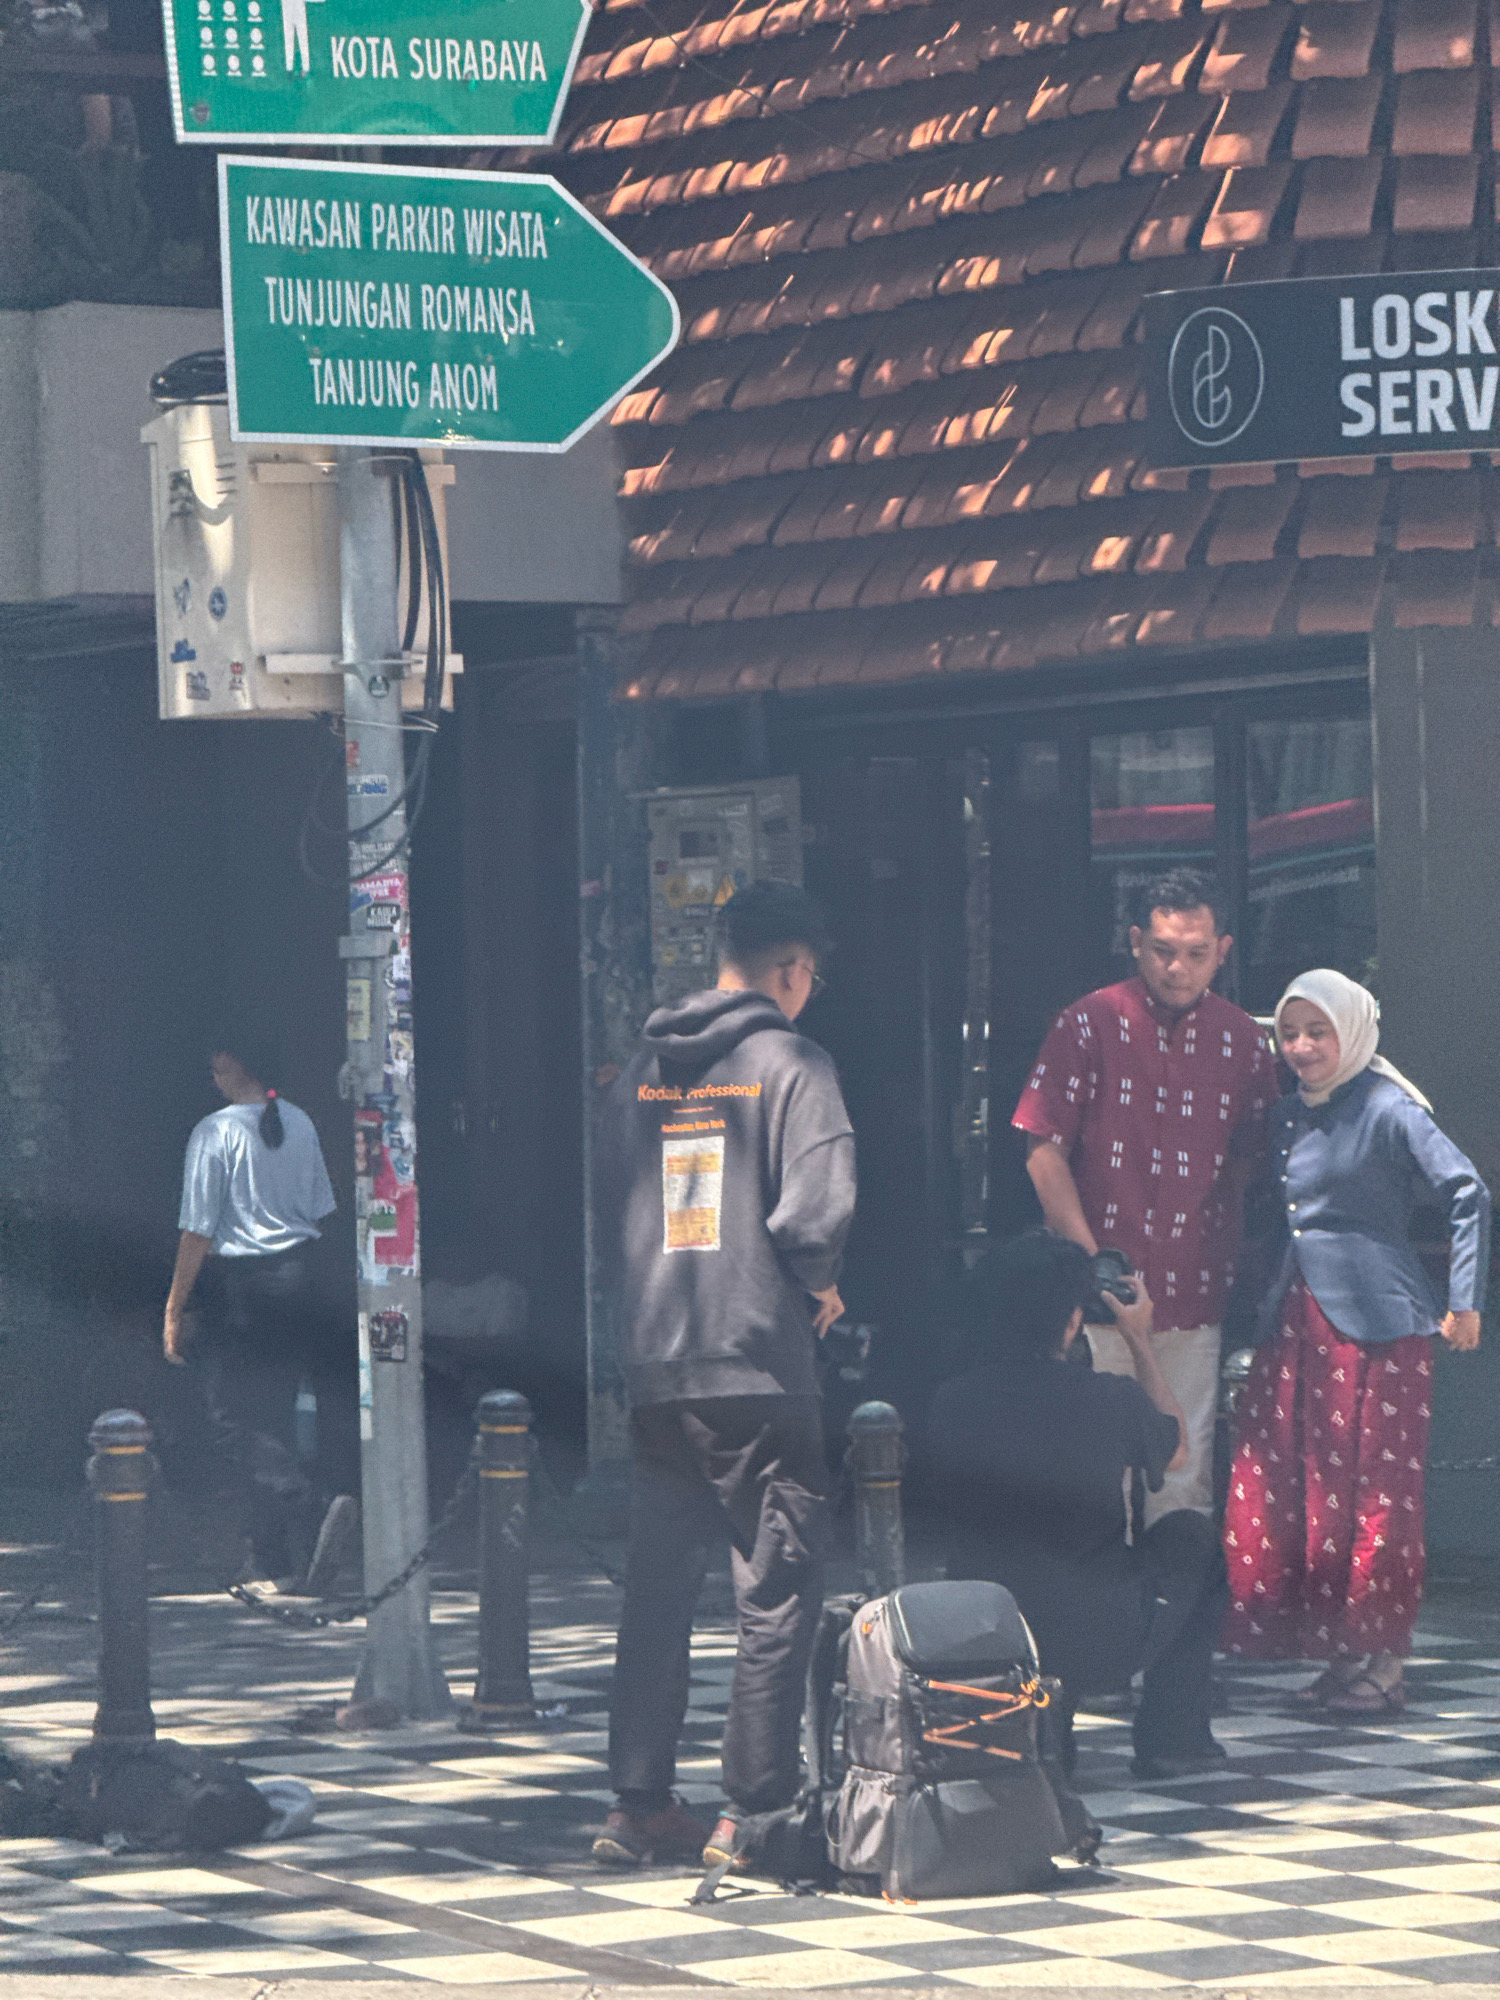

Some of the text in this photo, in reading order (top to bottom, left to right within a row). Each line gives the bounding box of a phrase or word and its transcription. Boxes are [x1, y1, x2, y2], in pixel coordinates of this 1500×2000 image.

[331, 36, 547, 82] KOTA SURABAYA
[246, 196, 548, 258] KAWASAN PARKIR WISATA
[264, 276, 536, 336] TUNJUNGAN ROMANSA
[309, 358, 498, 411] TANJUNG ANOM
[1340, 366, 1499, 437] SERV
